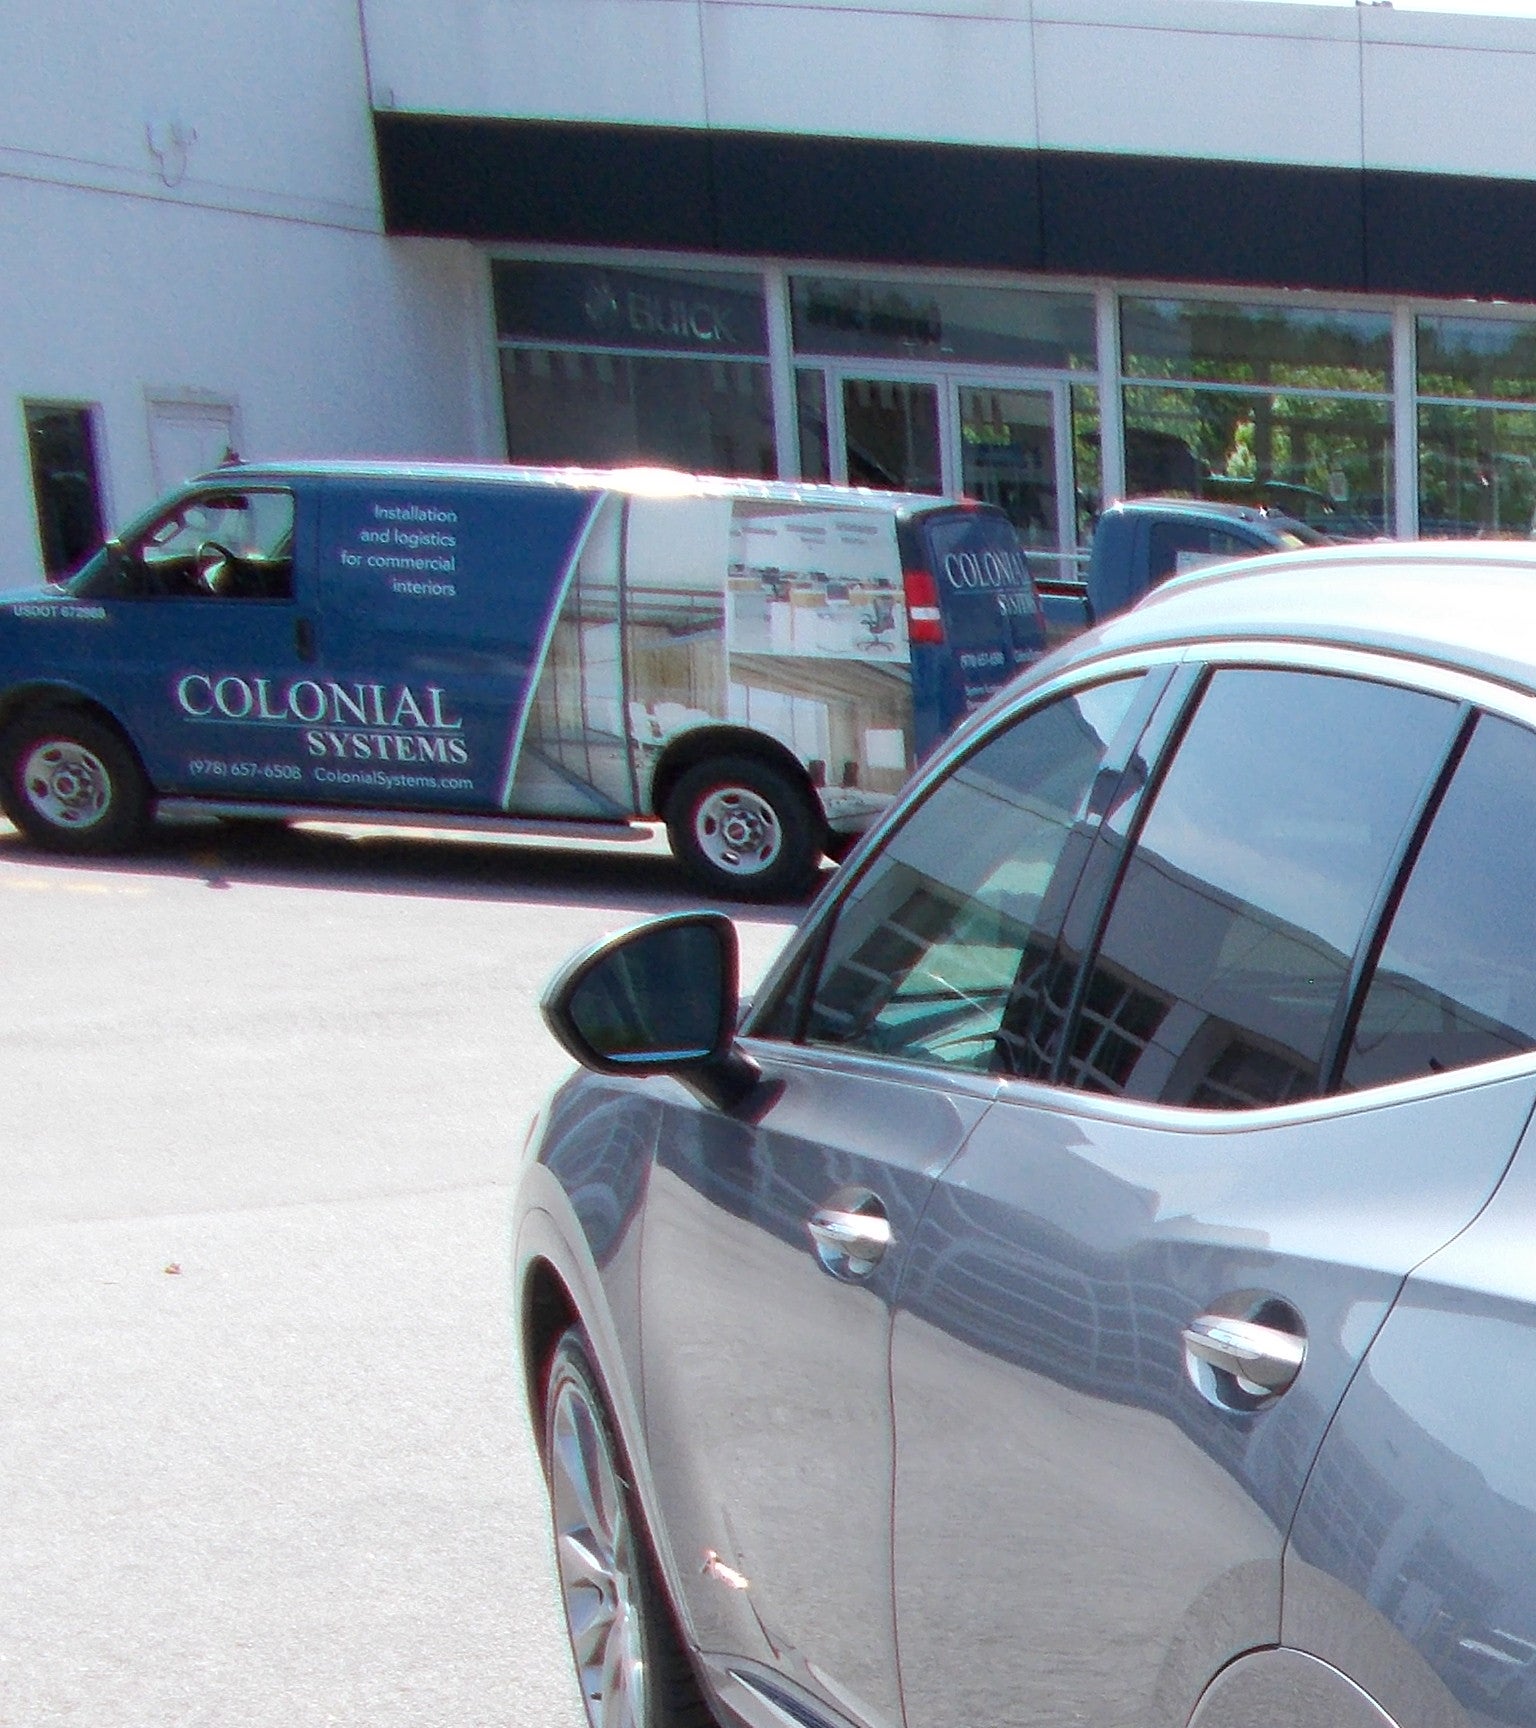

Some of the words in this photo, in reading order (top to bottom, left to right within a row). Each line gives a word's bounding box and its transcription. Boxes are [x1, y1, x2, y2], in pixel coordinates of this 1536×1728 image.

[374, 505, 458, 522] Installation
[360, 529, 390, 543] and
[394, 529, 456, 548] logistics
[341, 550, 361, 566] for
[367, 556, 456, 571] commercial
[392, 578, 456, 596] interiors
[13, 604, 57, 618] USDOT
[177, 674, 463, 729] COLONIAL
[306, 730, 468, 764] SYSTEMS
[189, 759, 228, 777] (978)
[314, 766, 474, 791] ColonialSystems.com
